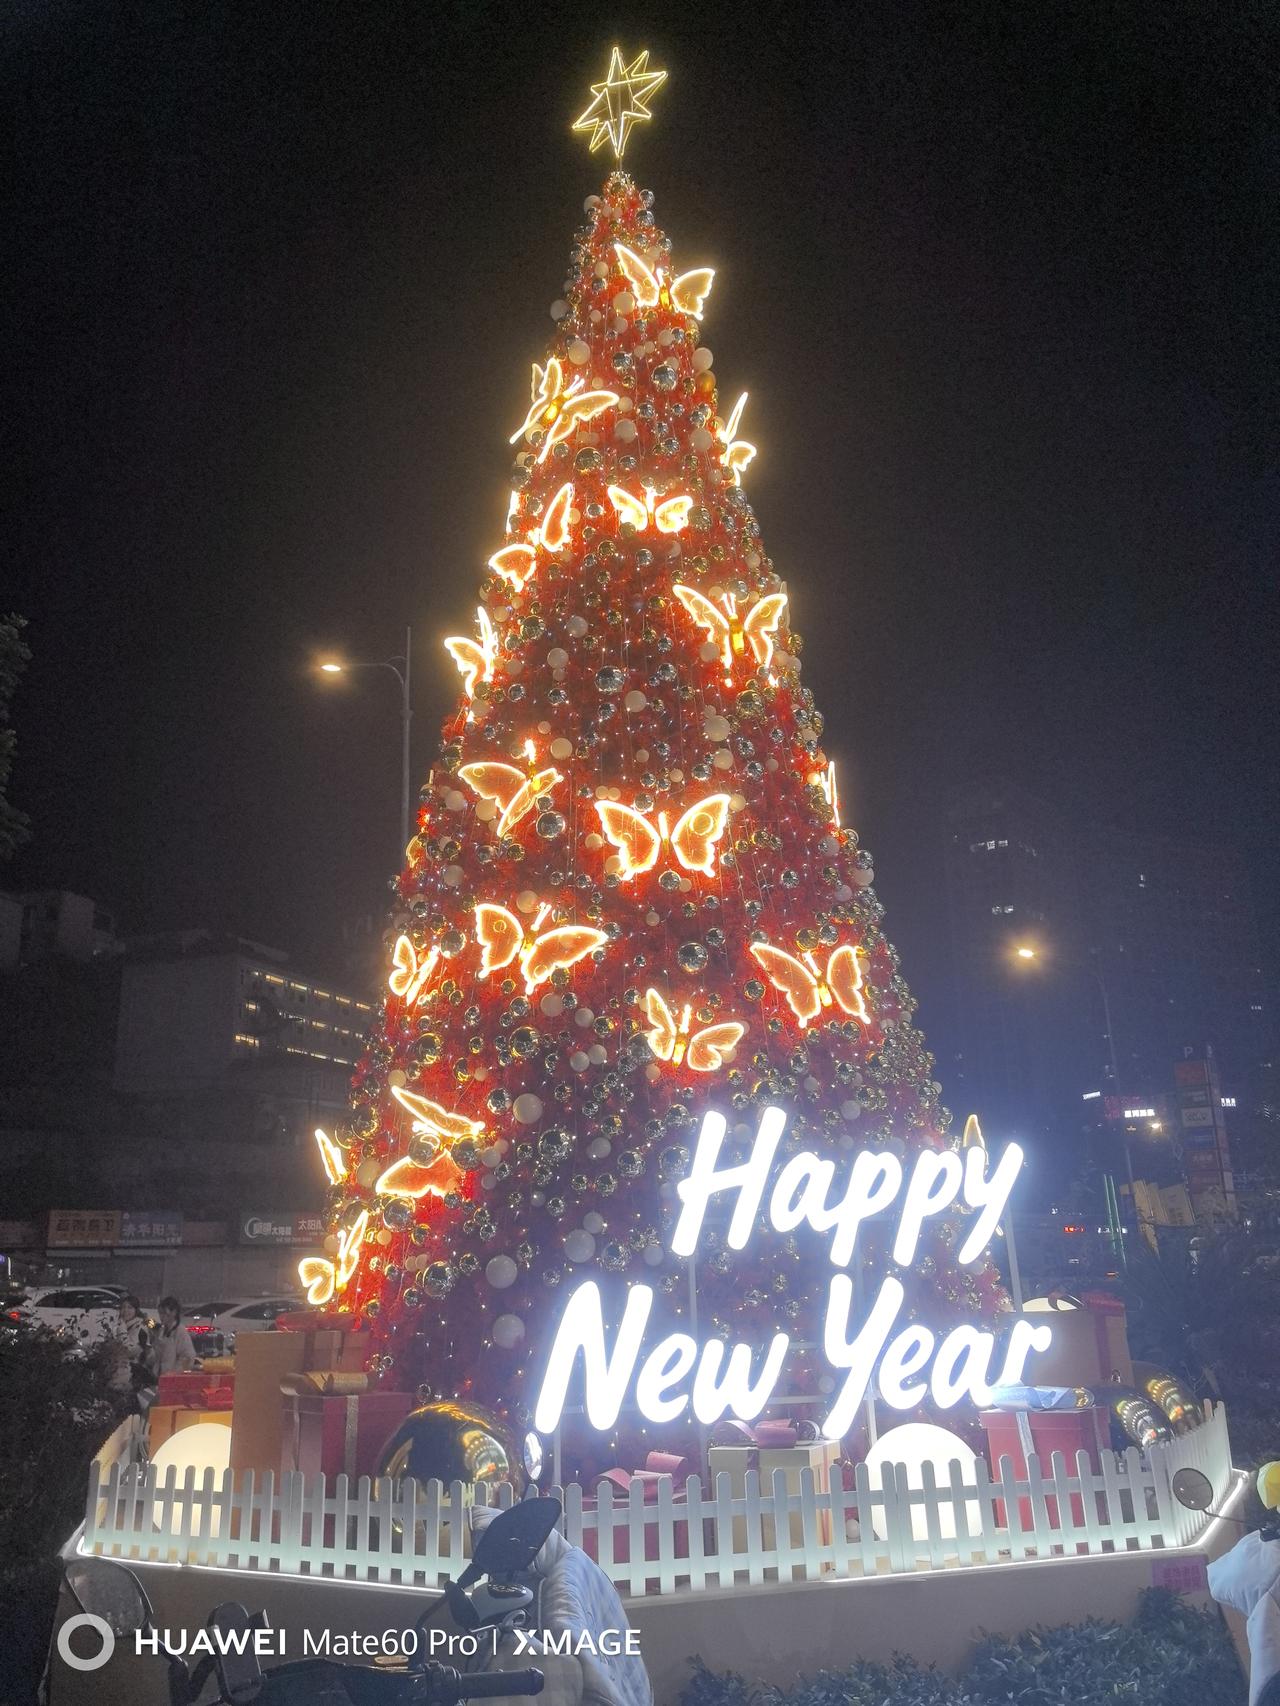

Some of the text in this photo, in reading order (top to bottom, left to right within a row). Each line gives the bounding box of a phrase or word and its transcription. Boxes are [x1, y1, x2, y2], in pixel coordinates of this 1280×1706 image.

[672, 1106, 1024, 1268] Happy
[535, 1274, 1052, 1441] New Year
